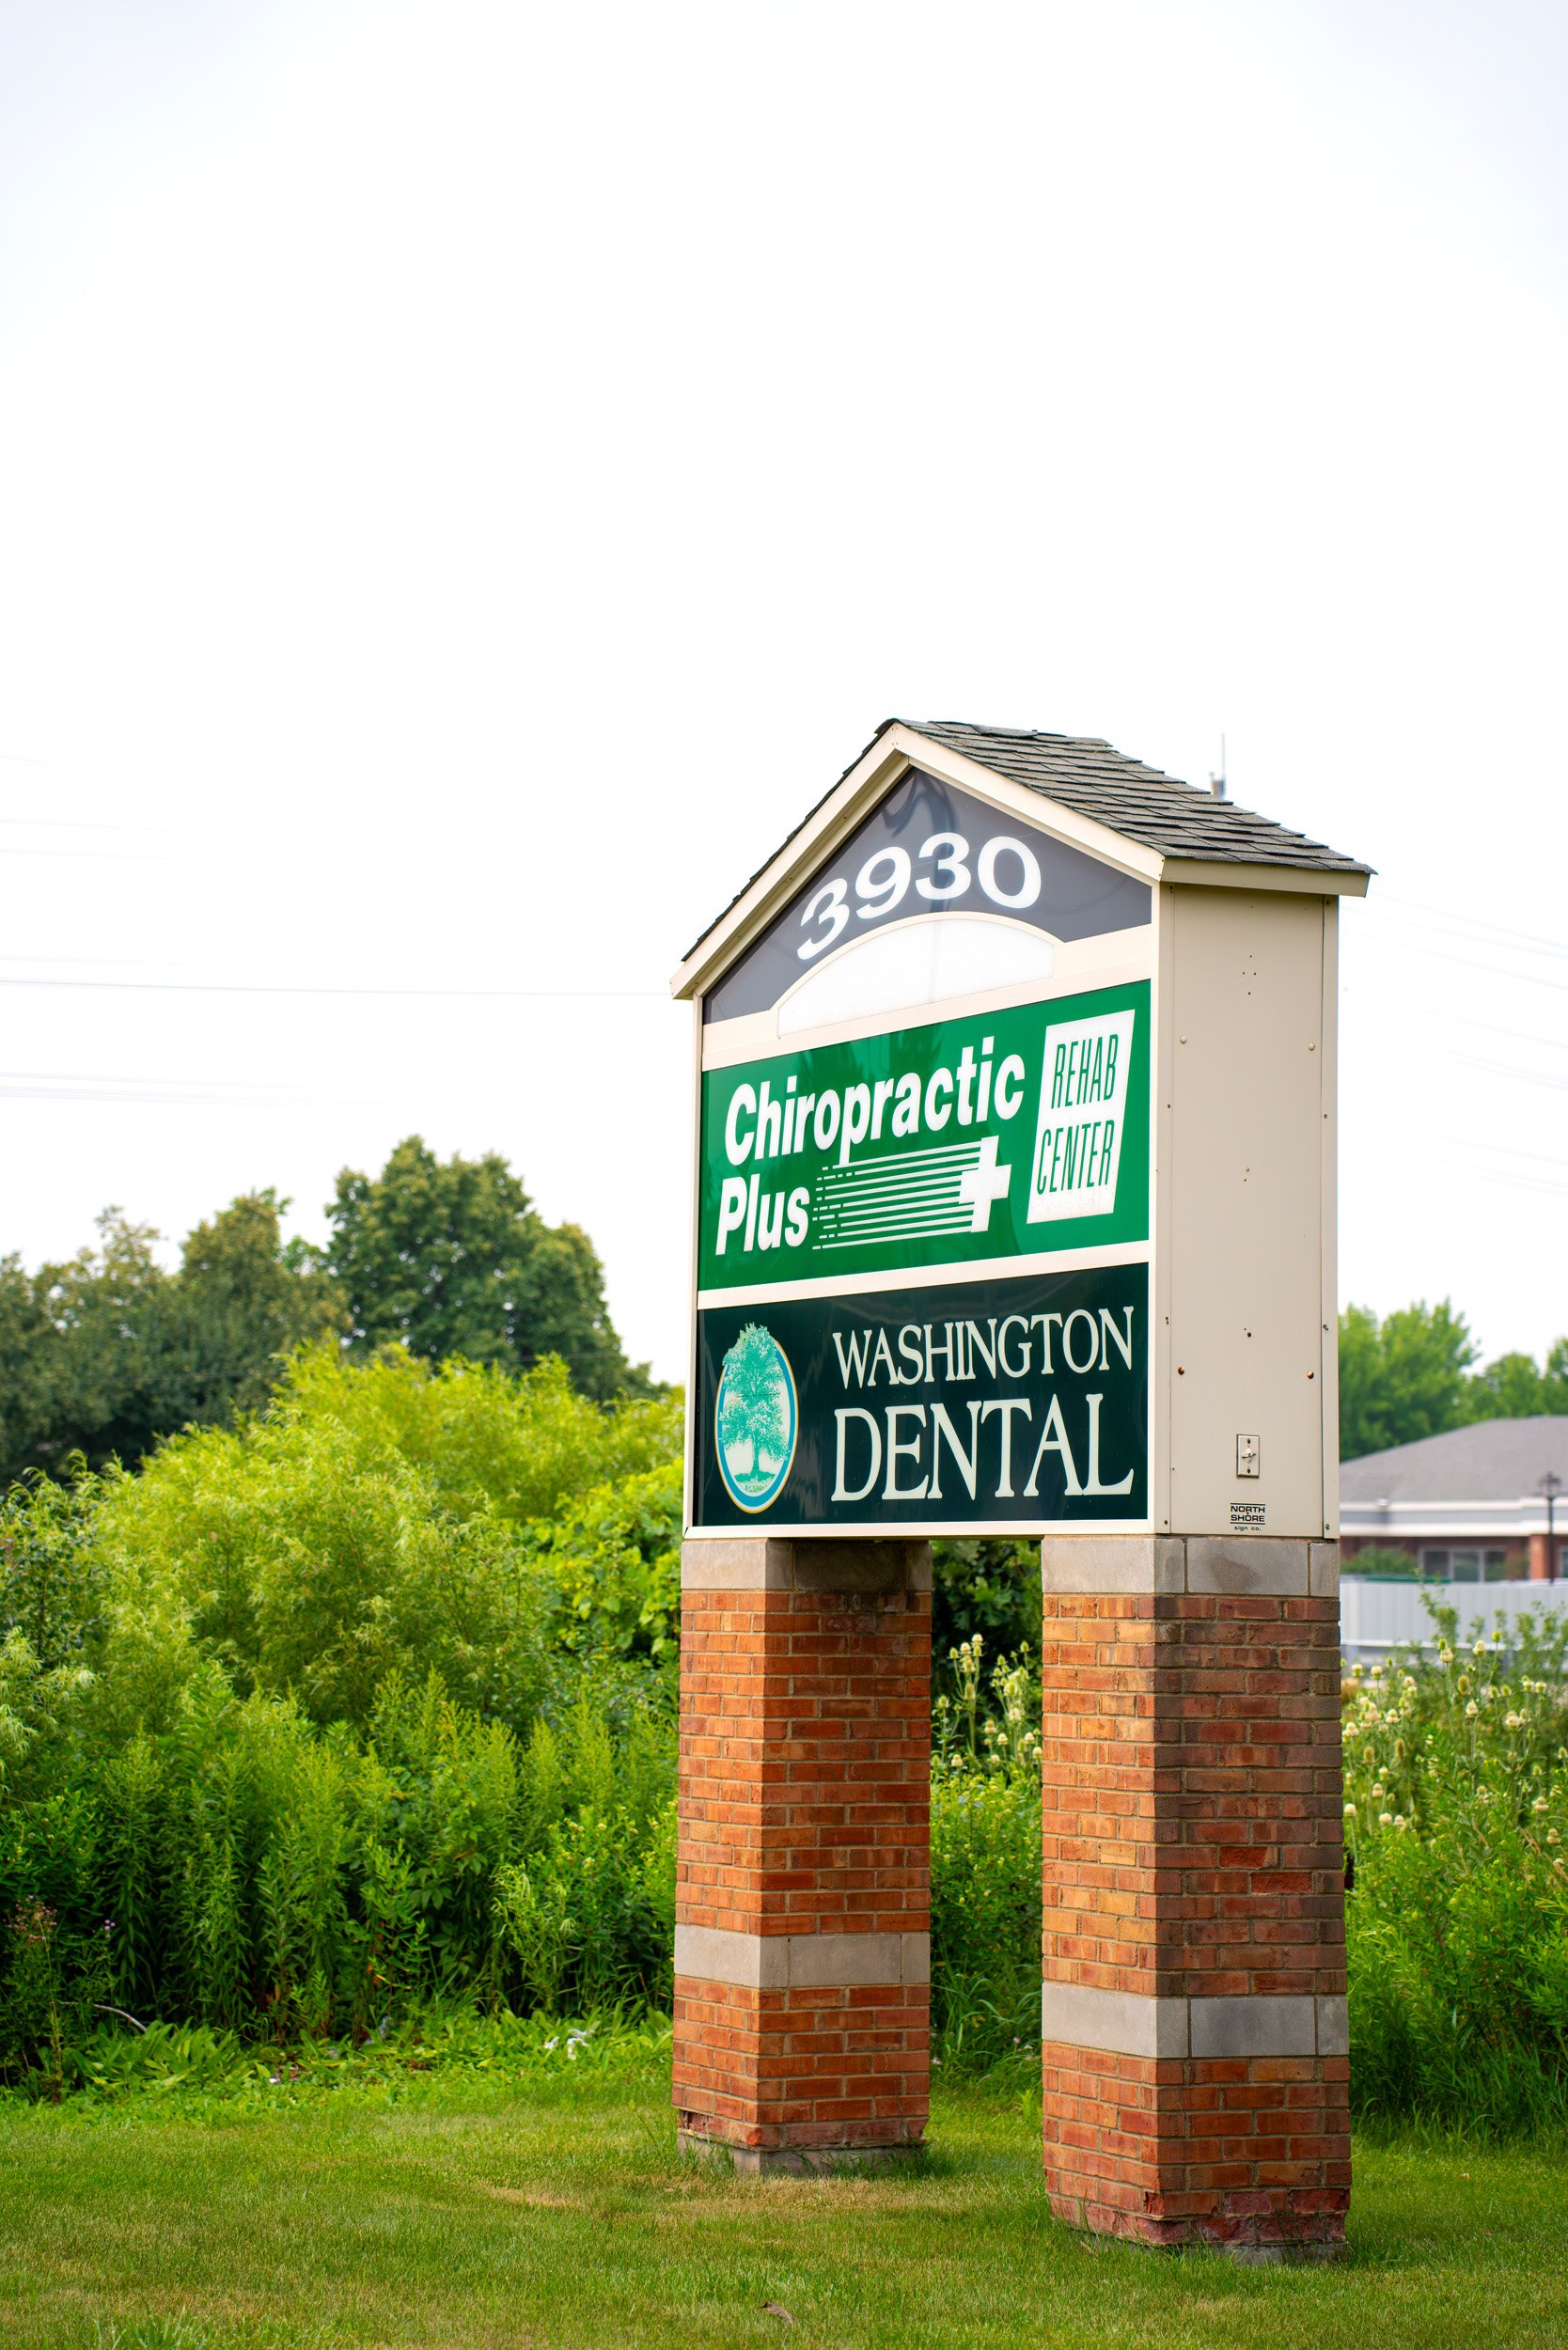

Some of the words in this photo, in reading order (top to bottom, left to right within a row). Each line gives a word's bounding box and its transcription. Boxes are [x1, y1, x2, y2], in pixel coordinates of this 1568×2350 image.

[797, 832, 1042, 960] 3930
[725, 1036, 1025, 1166] Chiropractic
[1051, 1034, 1119, 1109] REHAB
[1036, 1120, 1115, 1195] CENTER
[715, 1173, 810, 1255] Plus
[832, 1306, 1135, 1389] WASHINGTON
[831, 1393, 1135, 1501] DENTAL
